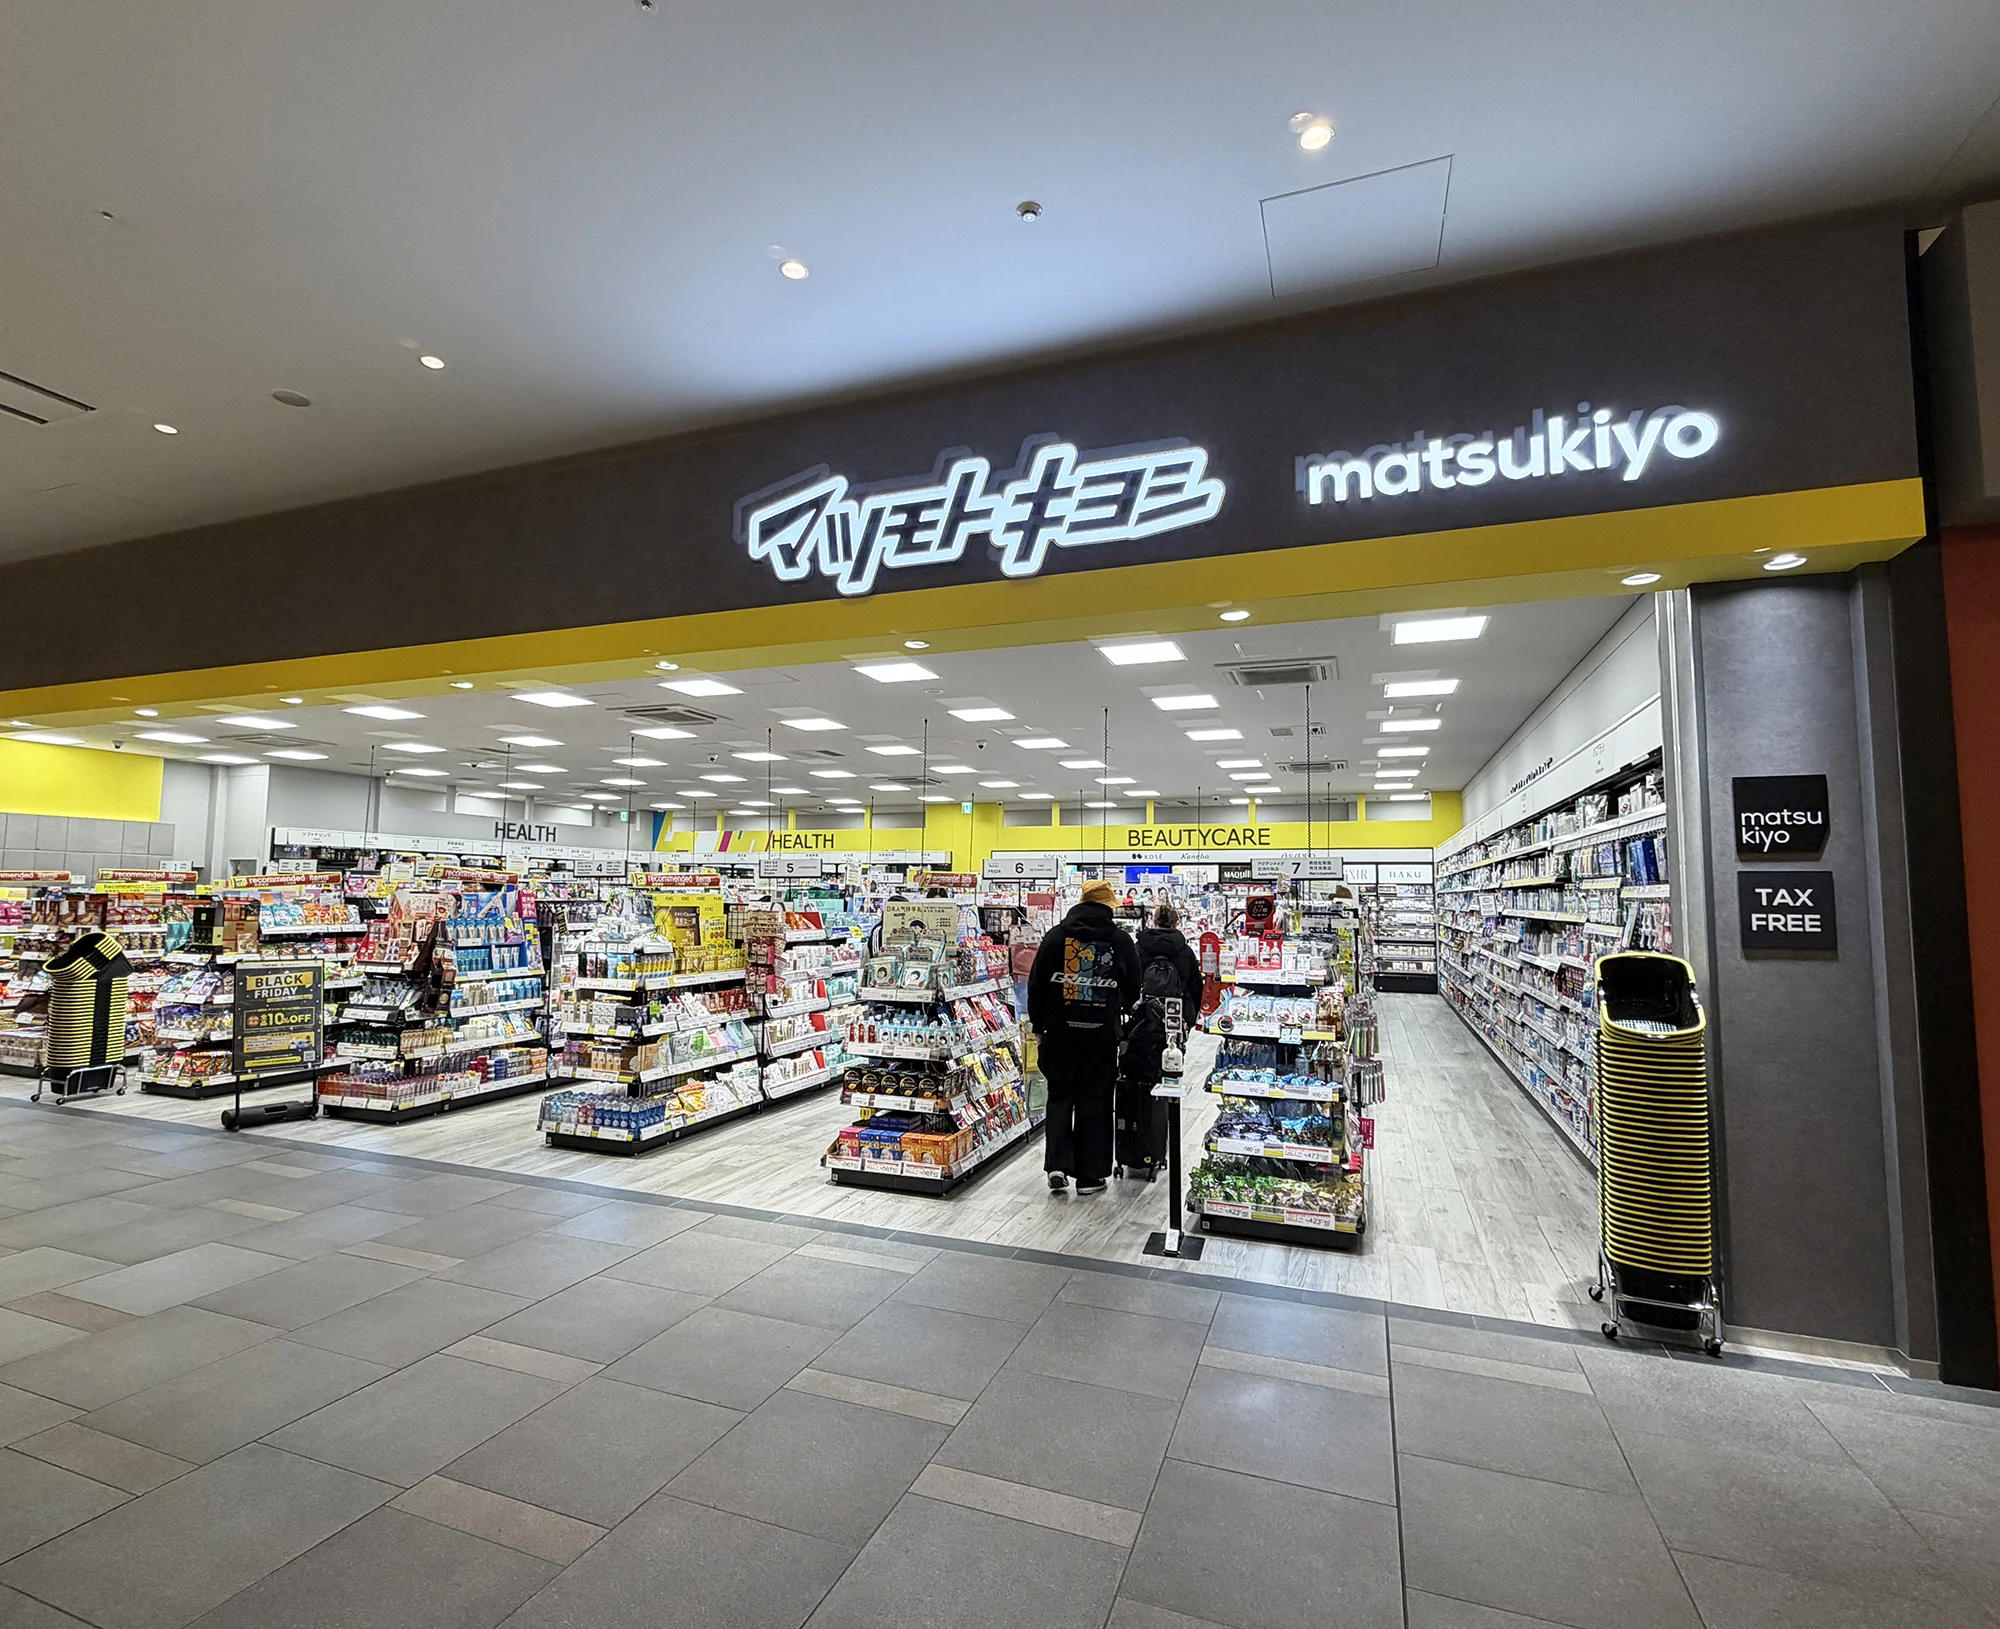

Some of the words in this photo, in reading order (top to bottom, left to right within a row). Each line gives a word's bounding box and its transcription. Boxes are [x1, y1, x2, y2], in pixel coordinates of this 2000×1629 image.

[1308, 409, 1719, 506] matsukiyo
[1741, 809, 1822, 826] matsu
[494, 821, 556, 843] HEALTH
[1128, 828, 1271, 847] BEAUTYCARE
[771, 833, 834, 850] HEALTH
[1742, 826, 1790, 852] kiyo
[294, 862, 301, 871] 2
[596, 863, 603, 873] 4
[786, 863, 795, 873] 5
[1015, 862, 1025, 874] 6
[1291, 862, 1302, 875] 7
[114, 871, 166, 879] recommended
[248, 876, 305, 886] recommended
[308, 875, 329, 883] items
[647, 875, 693, 883] recommended
[1755, 888, 1814, 907] TAX
[1751, 913, 1822, 933] FREE
[255, 974, 304, 988] BLACK
[254, 986, 298, 999] FRIDAY
